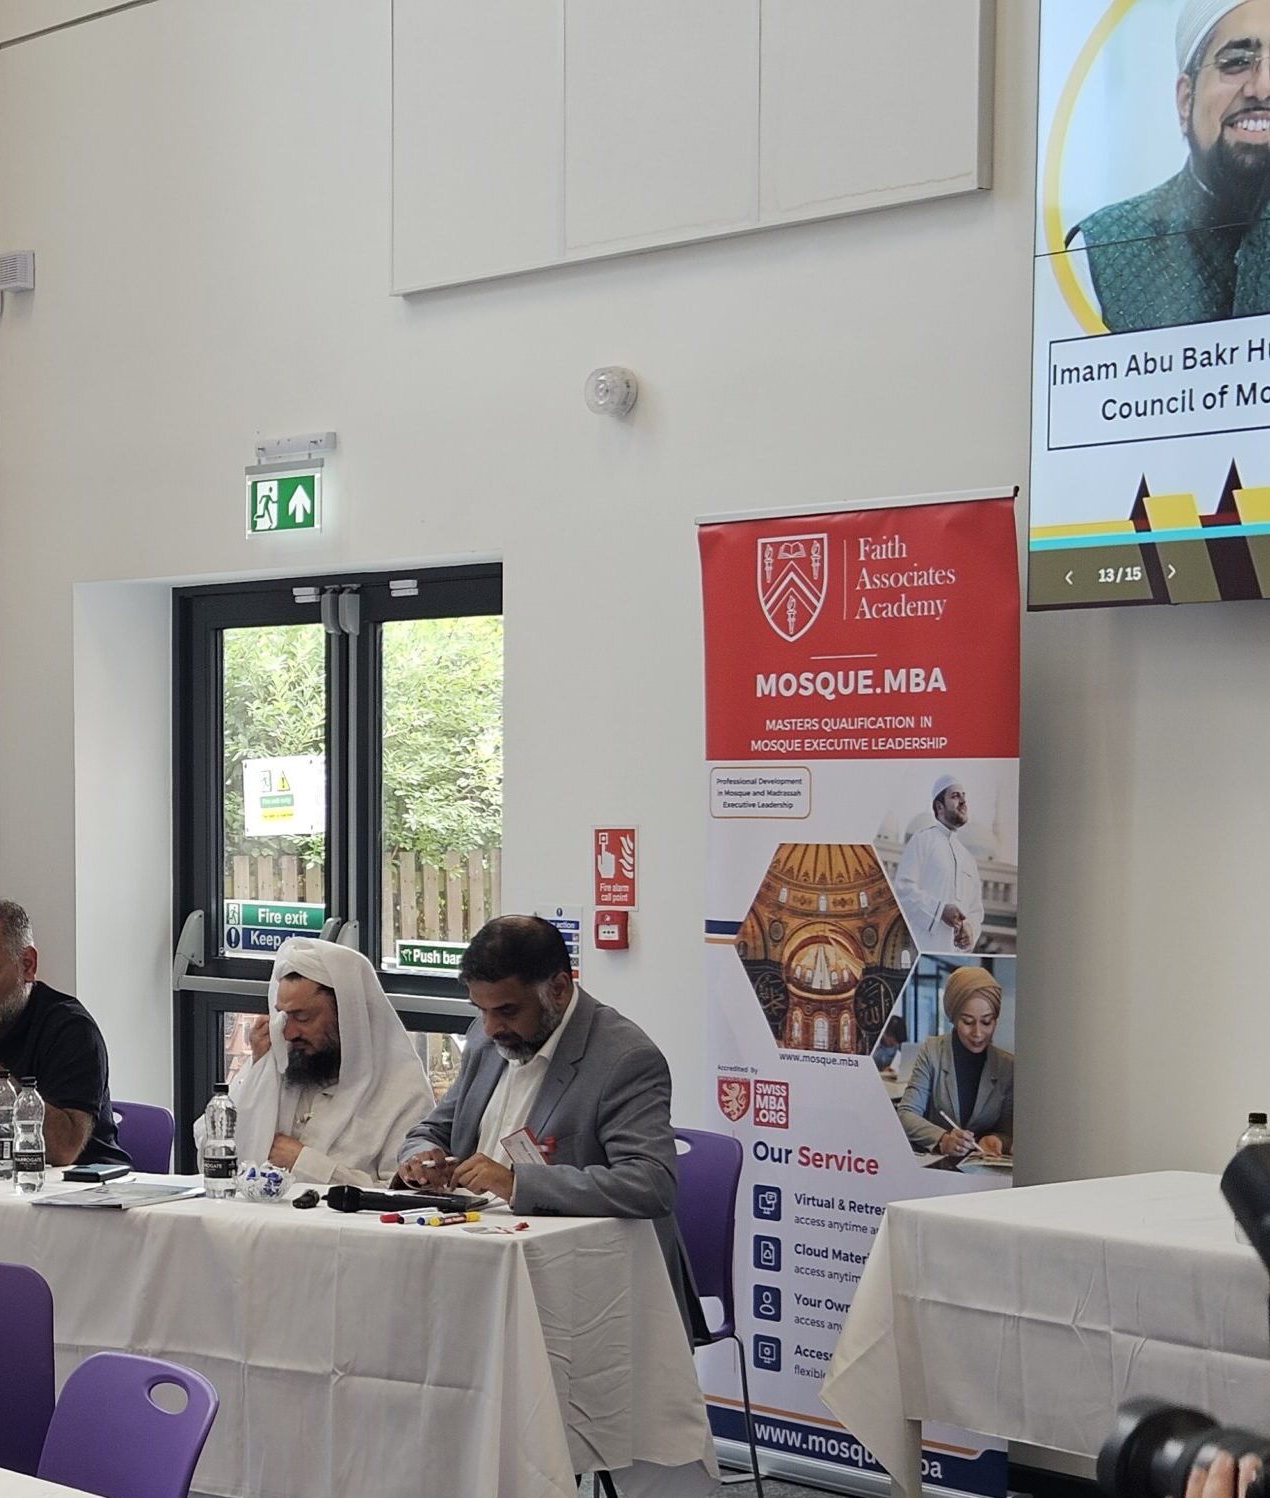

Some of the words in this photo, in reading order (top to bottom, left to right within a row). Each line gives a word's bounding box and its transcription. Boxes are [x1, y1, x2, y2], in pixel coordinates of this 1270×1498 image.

[1052, 361, 1118, 386] Imam
[1125, 351, 1173, 377] Abu
[1183, 342, 1239, 370] Bakr
[1248, 338, 1270, 362] H
[1101, 388, 1195, 420] Council
[1203, 384, 1229, 410] of
[857, 535, 908, 561] Faith
[855, 563, 956, 591] Associates
[1097, 566, 1142, 583] 13/15
[854, 593, 947, 621] Academy
[755, 667, 947, 701] MOSQUE.MBA
[766, 718, 819, 732] MASTERS
[821, 716, 915, 732] QUALIFICATION
[920, 716, 932, 728] IN
[750, 739, 801, 754] MOSQUE
[804, 737, 869, 752] EXECUTIVE
[871, 737, 947, 751] LEADERSHIP
[257, 907, 282, 924] Fire
[285, 910, 308, 926] exit
[250, 930, 281, 950] Keep
[413, 948, 441, 964] Push
[779, 1053, 859, 1068] www.mosque.mba
[755, 1083, 787, 1096] SWISS
[755, 1094, 786, 1111] MBA
[755, 1110, 787, 1124] .ORG
[753, 1141, 792, 1164] Our
[798, 1146, 879, 1175] Service
[794, 1193, 835, 1209] Virtual
[837, 1199, 846, 1211] &
[794, 1216, 825, 1228] access
[828, 1220, 868, 1233] anytime
[794, 1243, 829, 1259] Cloud
[794, 1265, 826, 1278] access
[794, 1293, 822, 1308] Your
[794, 1316, 826, 1329] access
